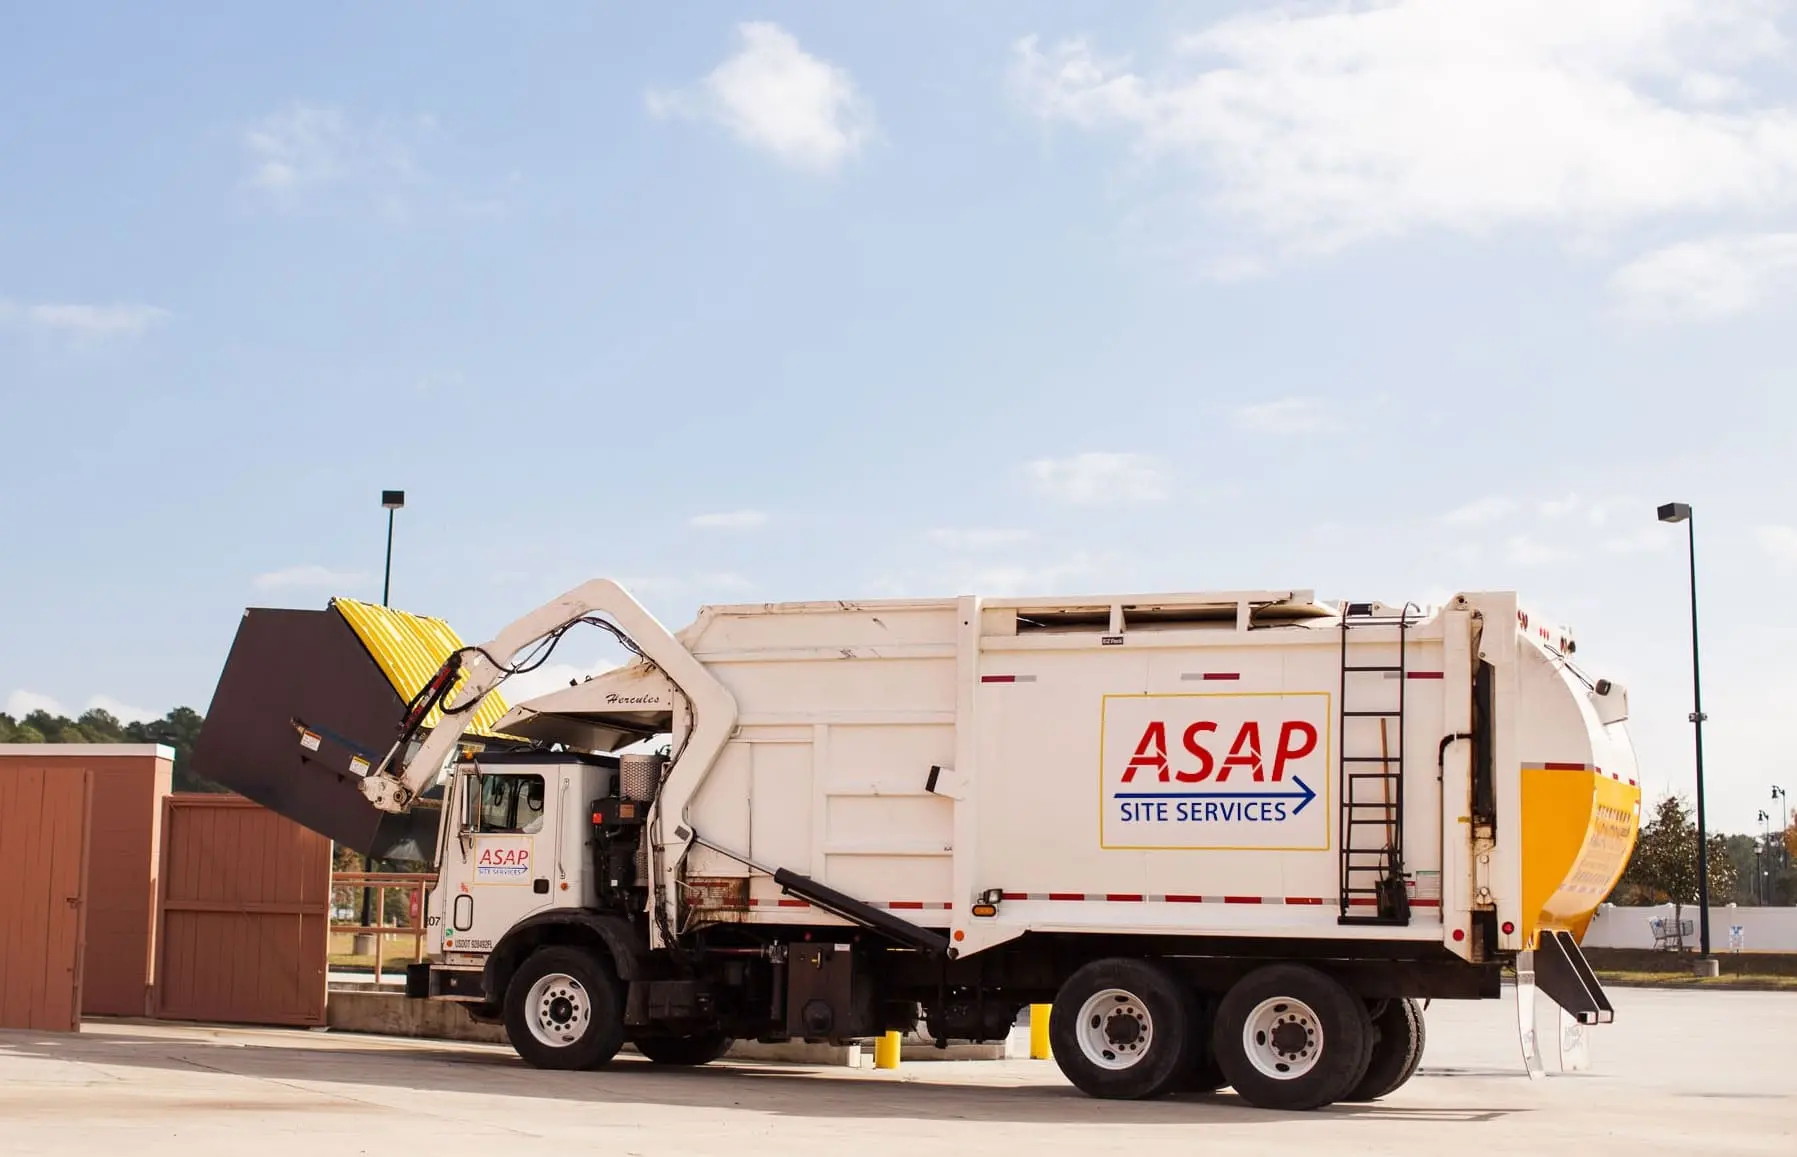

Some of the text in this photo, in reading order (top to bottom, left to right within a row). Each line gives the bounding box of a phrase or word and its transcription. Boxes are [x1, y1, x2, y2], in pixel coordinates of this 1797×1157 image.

[606, 693, 659, 704] Hercules
[1121, 721, 1317, 783] ASAP
[1120, 802, 1287, 822] SITE SERVICES
[480, 849, 529, 865] ASAP
